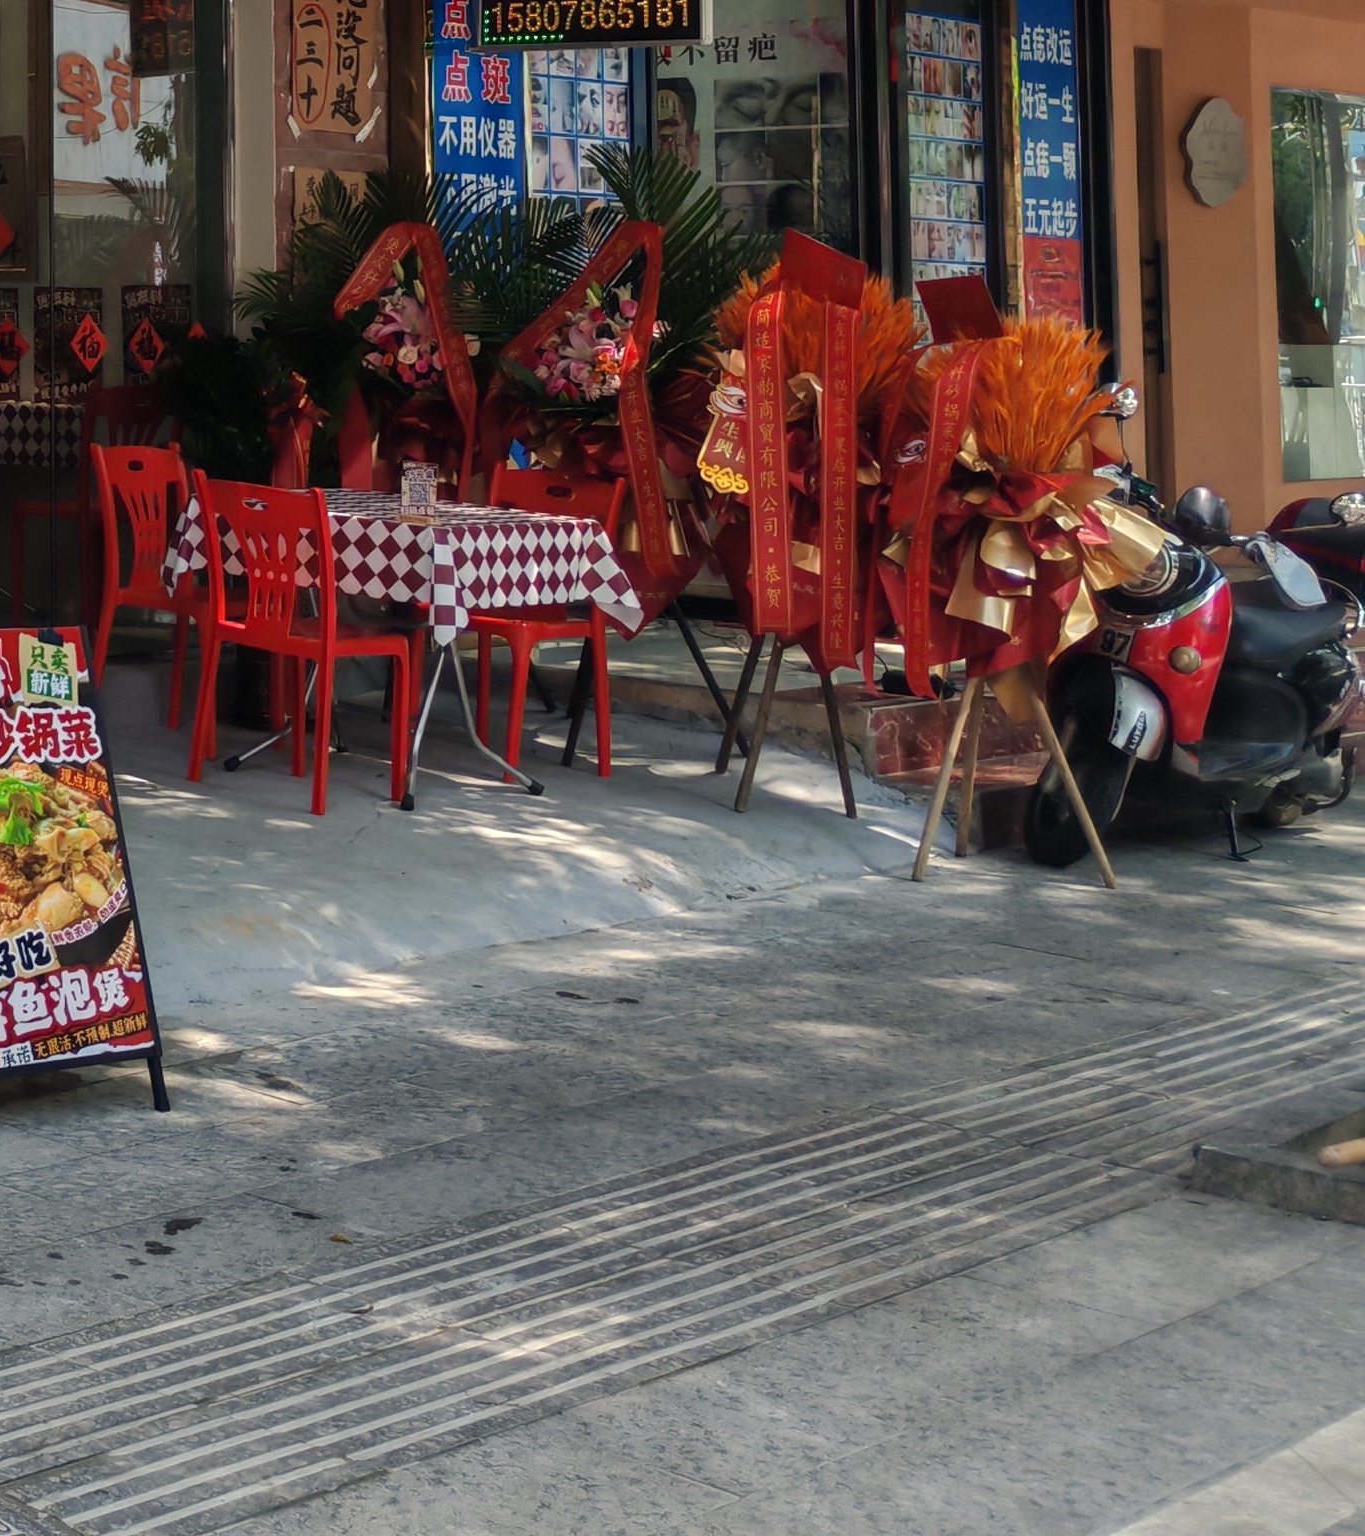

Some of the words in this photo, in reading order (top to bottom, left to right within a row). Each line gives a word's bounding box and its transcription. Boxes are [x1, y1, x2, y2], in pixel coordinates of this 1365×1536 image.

[1019, 21, 1073, 67] 点痣改运
[441, 48, 512, 105] 点斑
[1019, 80, 1075, 126] 好运一生
[437, 115, 517, 161] 不用仪器
[1022, 137, 1077, 182] 点痣一颗
[1023, 198, 1079, 241] 五元起步
[29, 644, 69, 670] 只卖
[29, 670, 70, 700] 新鲜
[59, 767, 109, 798] 现点现煲
[2, 1044, 32, 1067] 承诺
